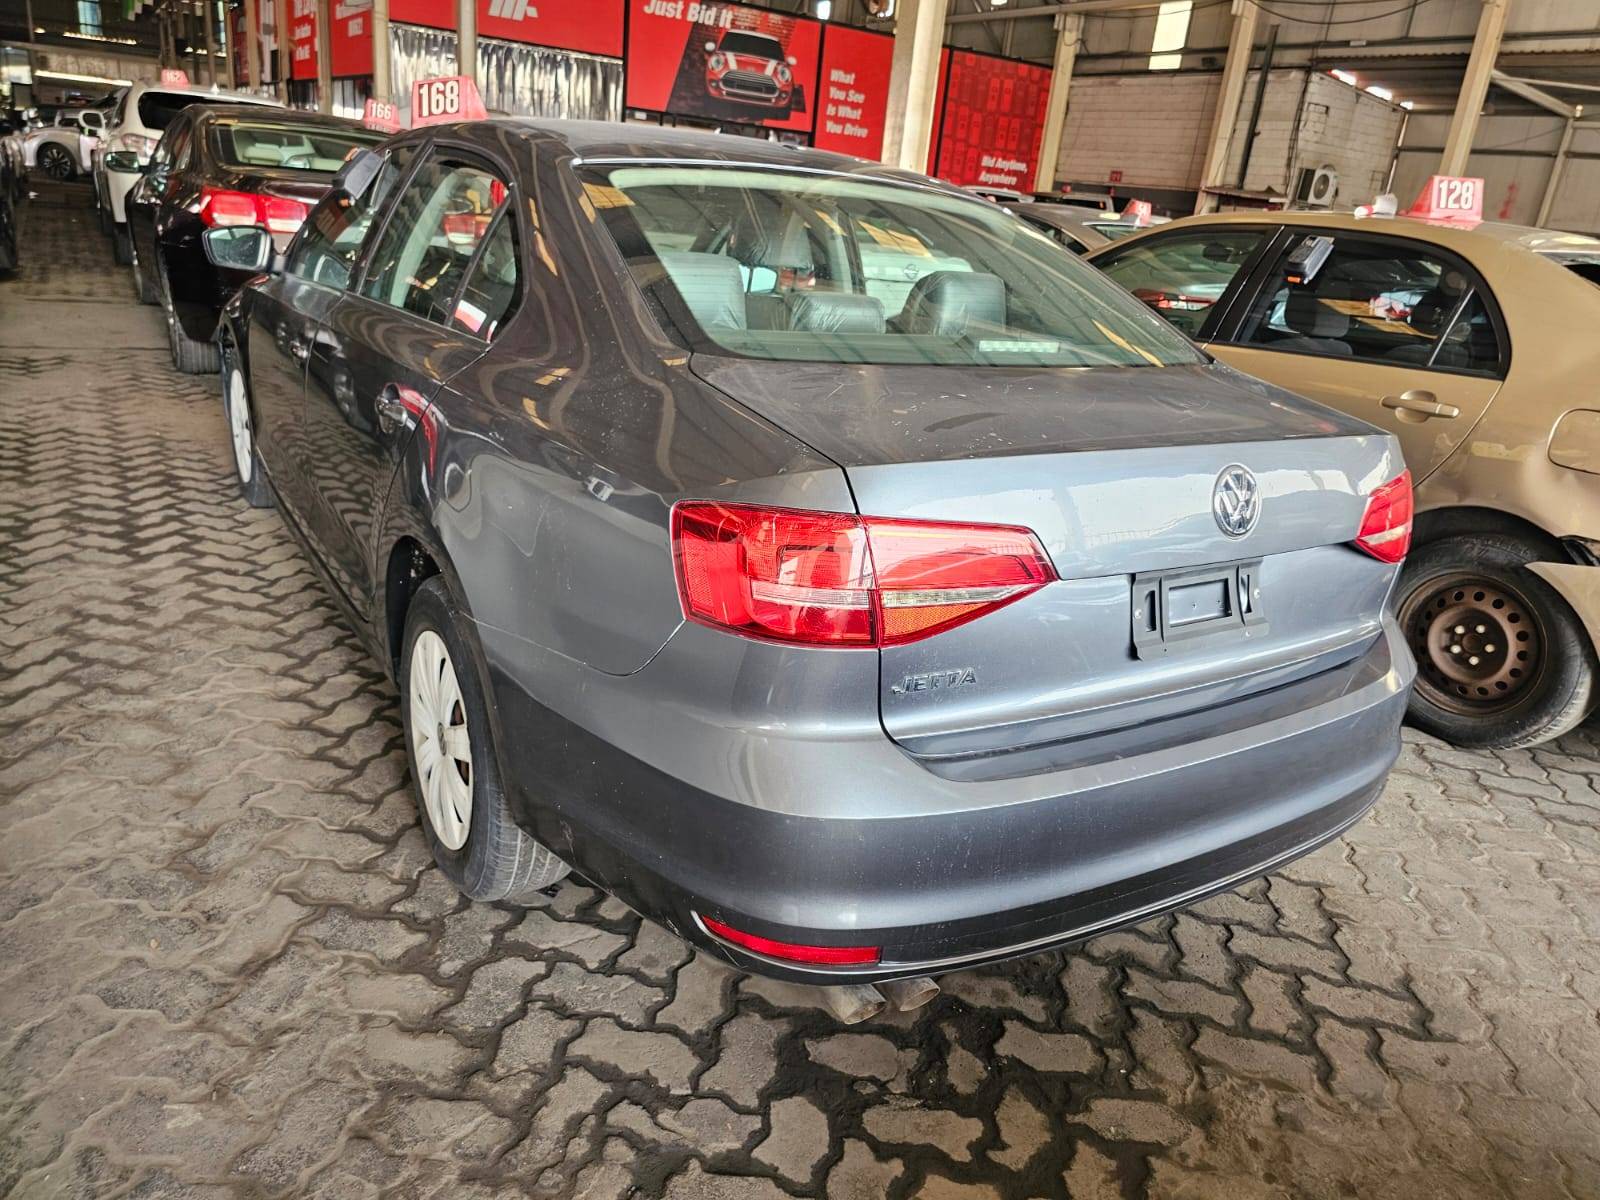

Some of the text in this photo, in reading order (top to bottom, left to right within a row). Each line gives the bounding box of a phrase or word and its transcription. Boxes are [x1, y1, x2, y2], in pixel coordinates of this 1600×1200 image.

[643, 0, 733, 29] Just Bid It
[830, 69, 856, 86] What
[419, 80, 459, 117] 168
[829, 86, 866, 104] You See
[371, 102, 392, 120] 166
[826, 103, 862, 120] Is What
[826, 120, 869, 138] You Drive
[981, 155, 996, 167] Bid
[978, 170, 1017, 185] Anywhere
[1439, 180, 1474, 210] 128
[891, 667, 977, 695] JETTA
